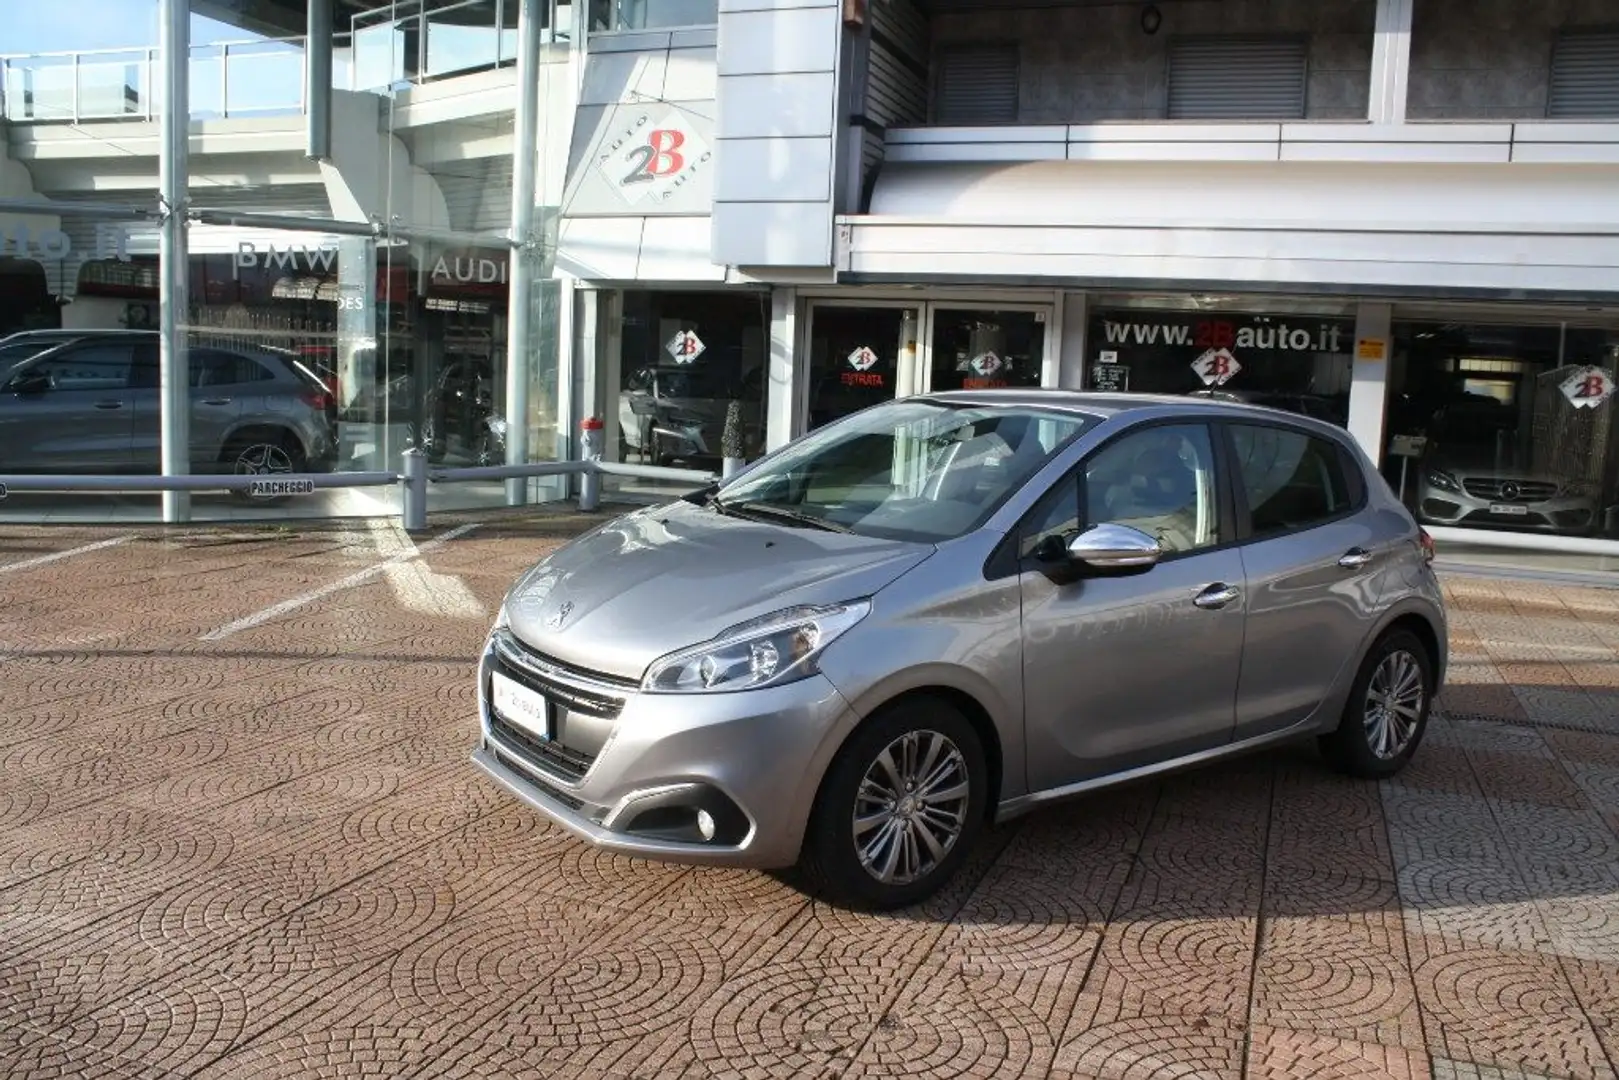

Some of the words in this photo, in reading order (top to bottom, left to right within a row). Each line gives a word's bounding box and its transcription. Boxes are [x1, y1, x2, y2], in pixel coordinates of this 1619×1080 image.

[619, 129, 686, 186] 2B
[0, 222, 132, 262] to.it
[238, 242, 338, 271] BMW
[431, 256, 506, 284] AUDI
[676, 337, 697, 356] 2B
[1204, 355, 1230, 376] 2B
[1574, 376, 1603, 398] 2B
[251, 481, 313, 494] PARCHEGGIO
